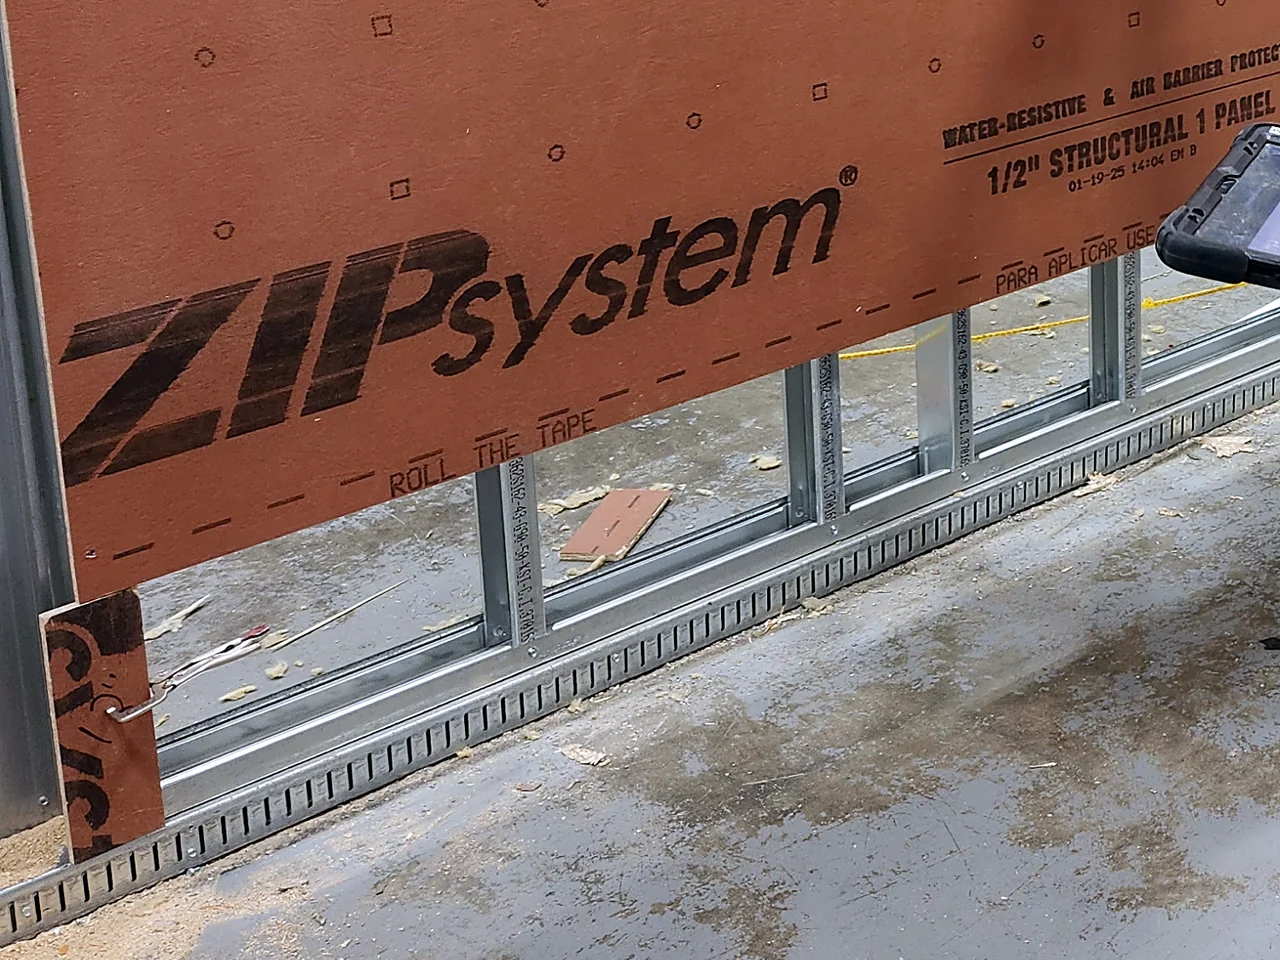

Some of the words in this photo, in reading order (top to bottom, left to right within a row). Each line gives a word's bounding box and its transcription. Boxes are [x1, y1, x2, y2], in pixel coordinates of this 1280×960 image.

[942, 94, 1086, 149] WATER-RESISTIVE
[1102, 87, 1116, 106] &
[1130, 76, 1156, 100] AIR
[1163, 59, 1224, 90] BARRIER
[988, 157, 1040, 195] 1/2"
[1049, 117, 1189, 177] STRUCTURAL
[1195, 108, 1206, 134] 1
[1214, 90, 1276, 130] PANEL
[1068, 165, 1126, 193] 01-19-25
[1131, 153, 1166, 175] 14:04
[1169, 149, 1186, 163] EM
[995, 265, 1039, 295] PARA
[1048, 238, 1118, 275] APLICAR
[1126, 228, 1155, 250] USE
[389, 455, 448, 498] ROLL
[472, 434, 521, 469] THE
[538, 406, 597, 450] TAPE
